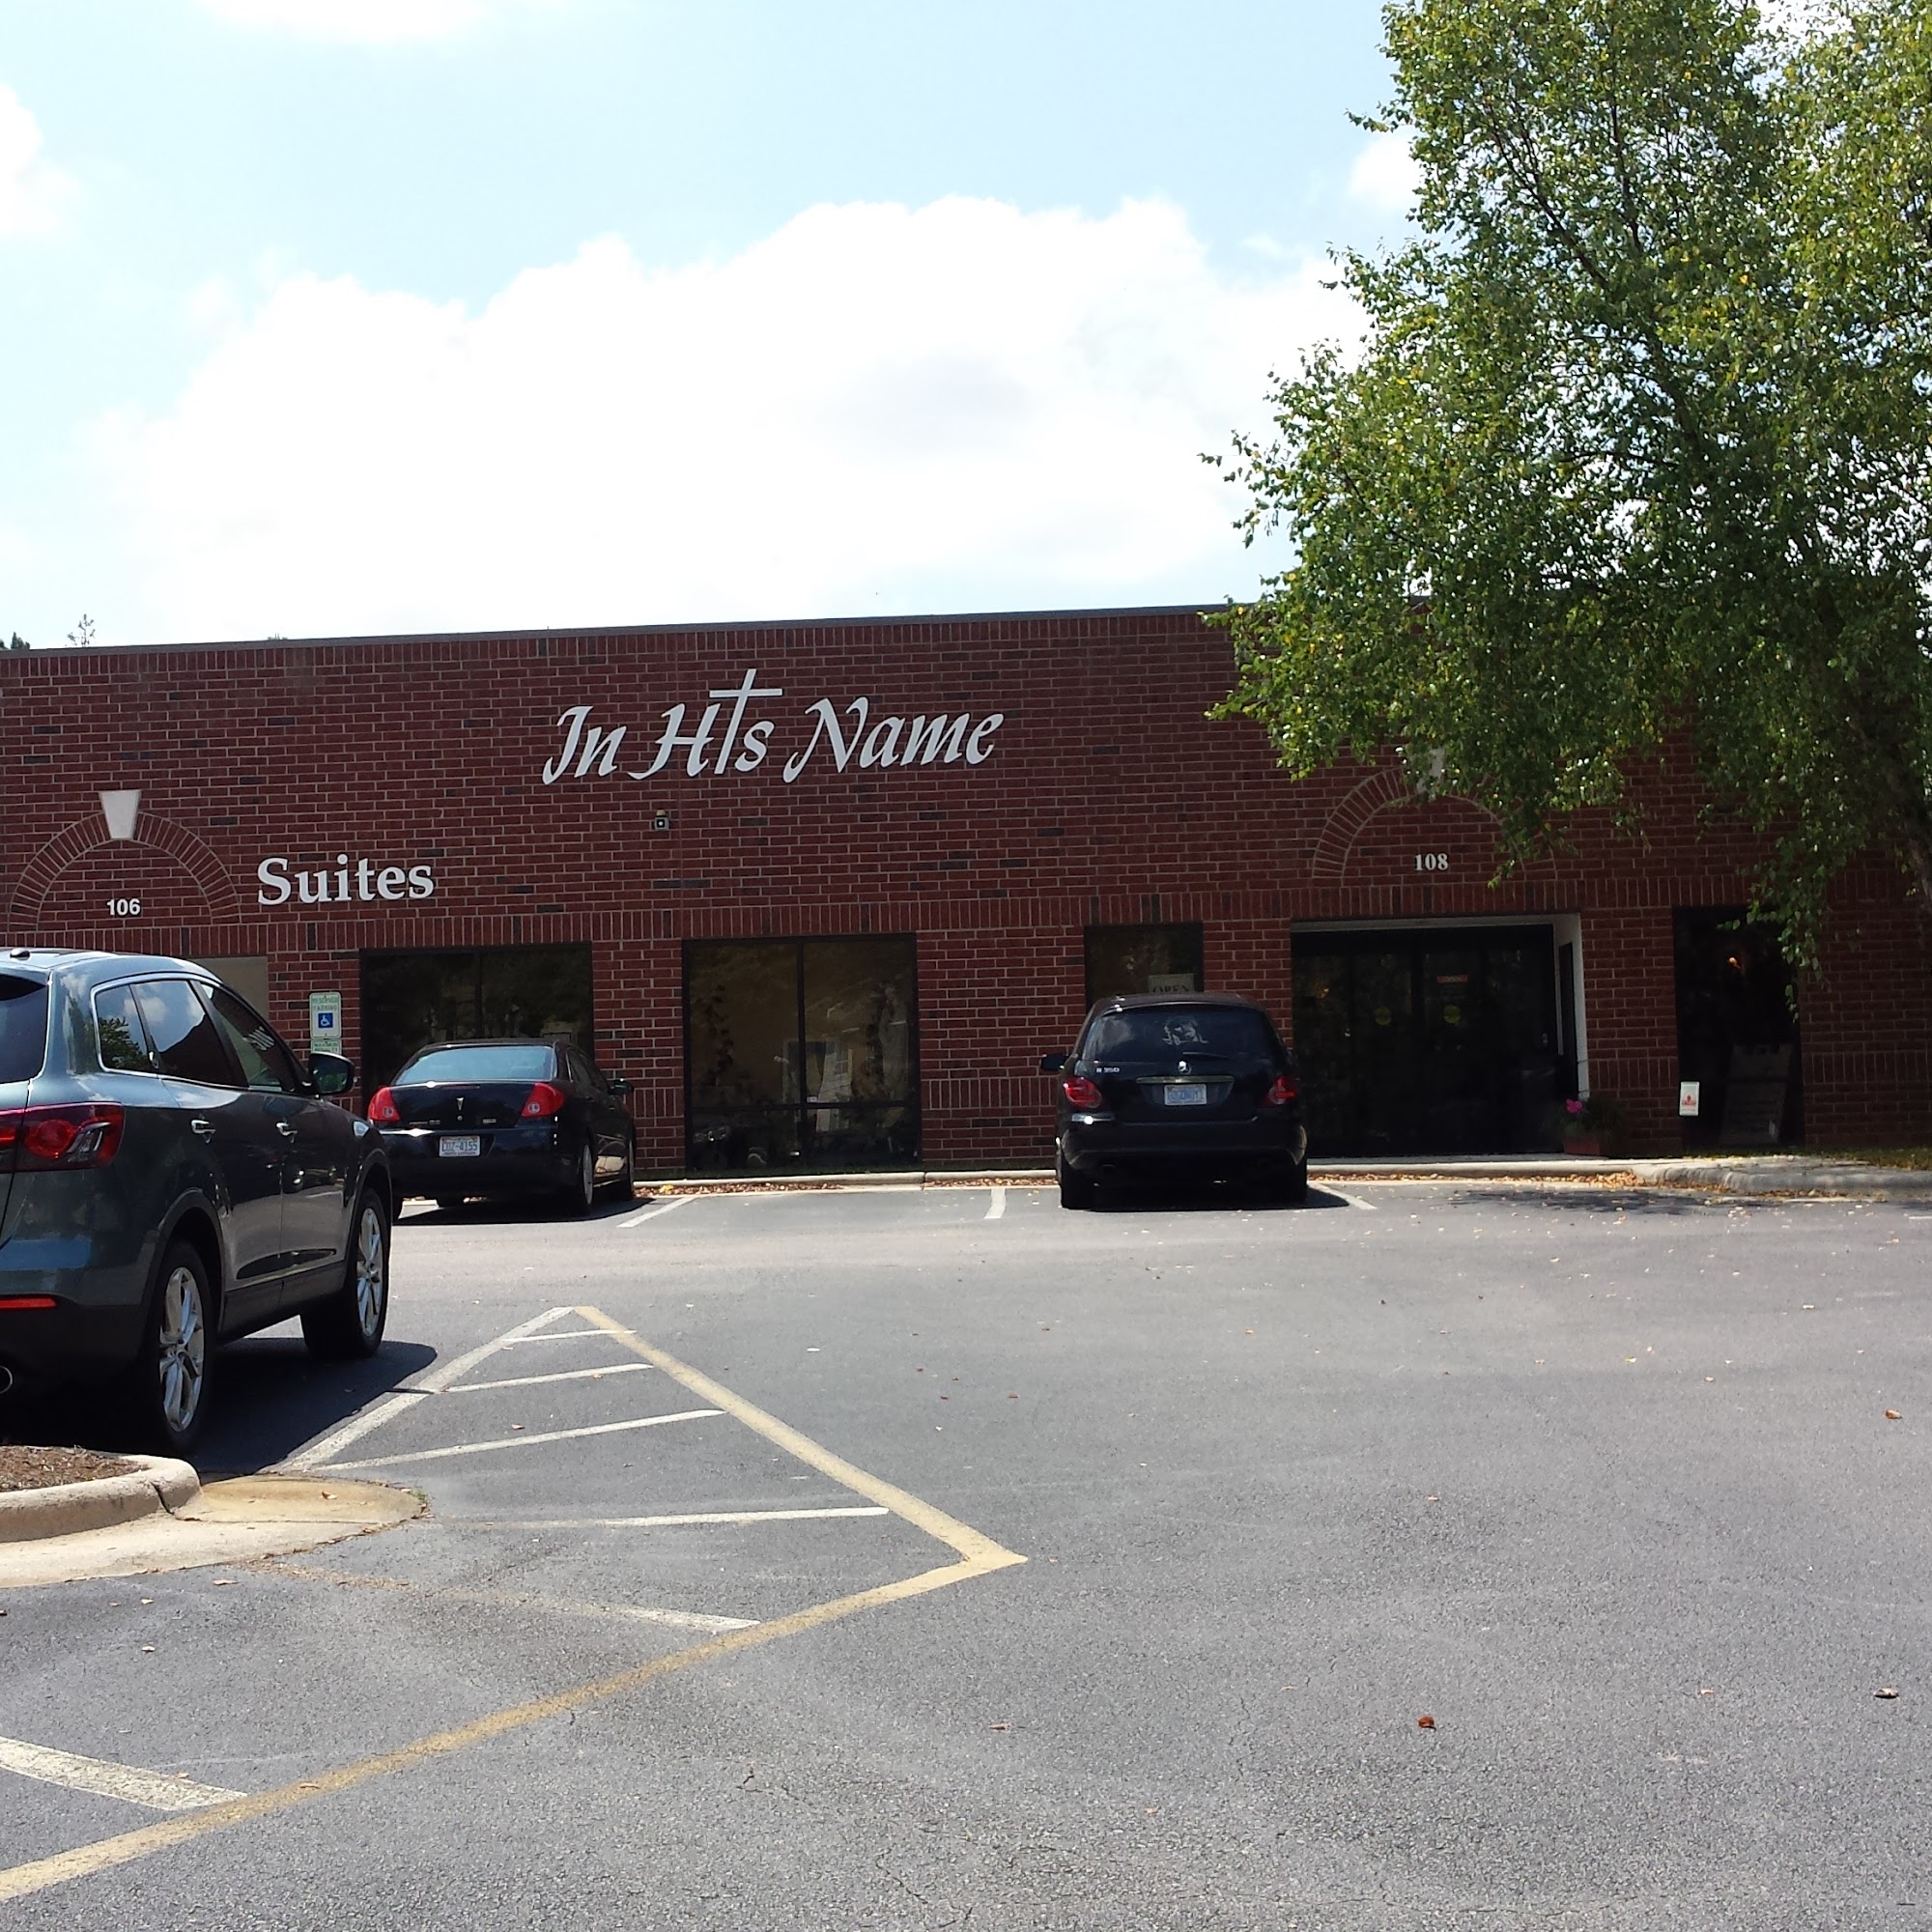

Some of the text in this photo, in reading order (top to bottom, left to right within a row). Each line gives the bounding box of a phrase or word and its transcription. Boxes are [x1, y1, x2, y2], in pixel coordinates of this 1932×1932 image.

[542, 668, 1005, 785] In His Name
[257, 853, 435, 905] Suites
[1414, 853, 1449, 870] 108
[106, 898, 141, 916] 106
